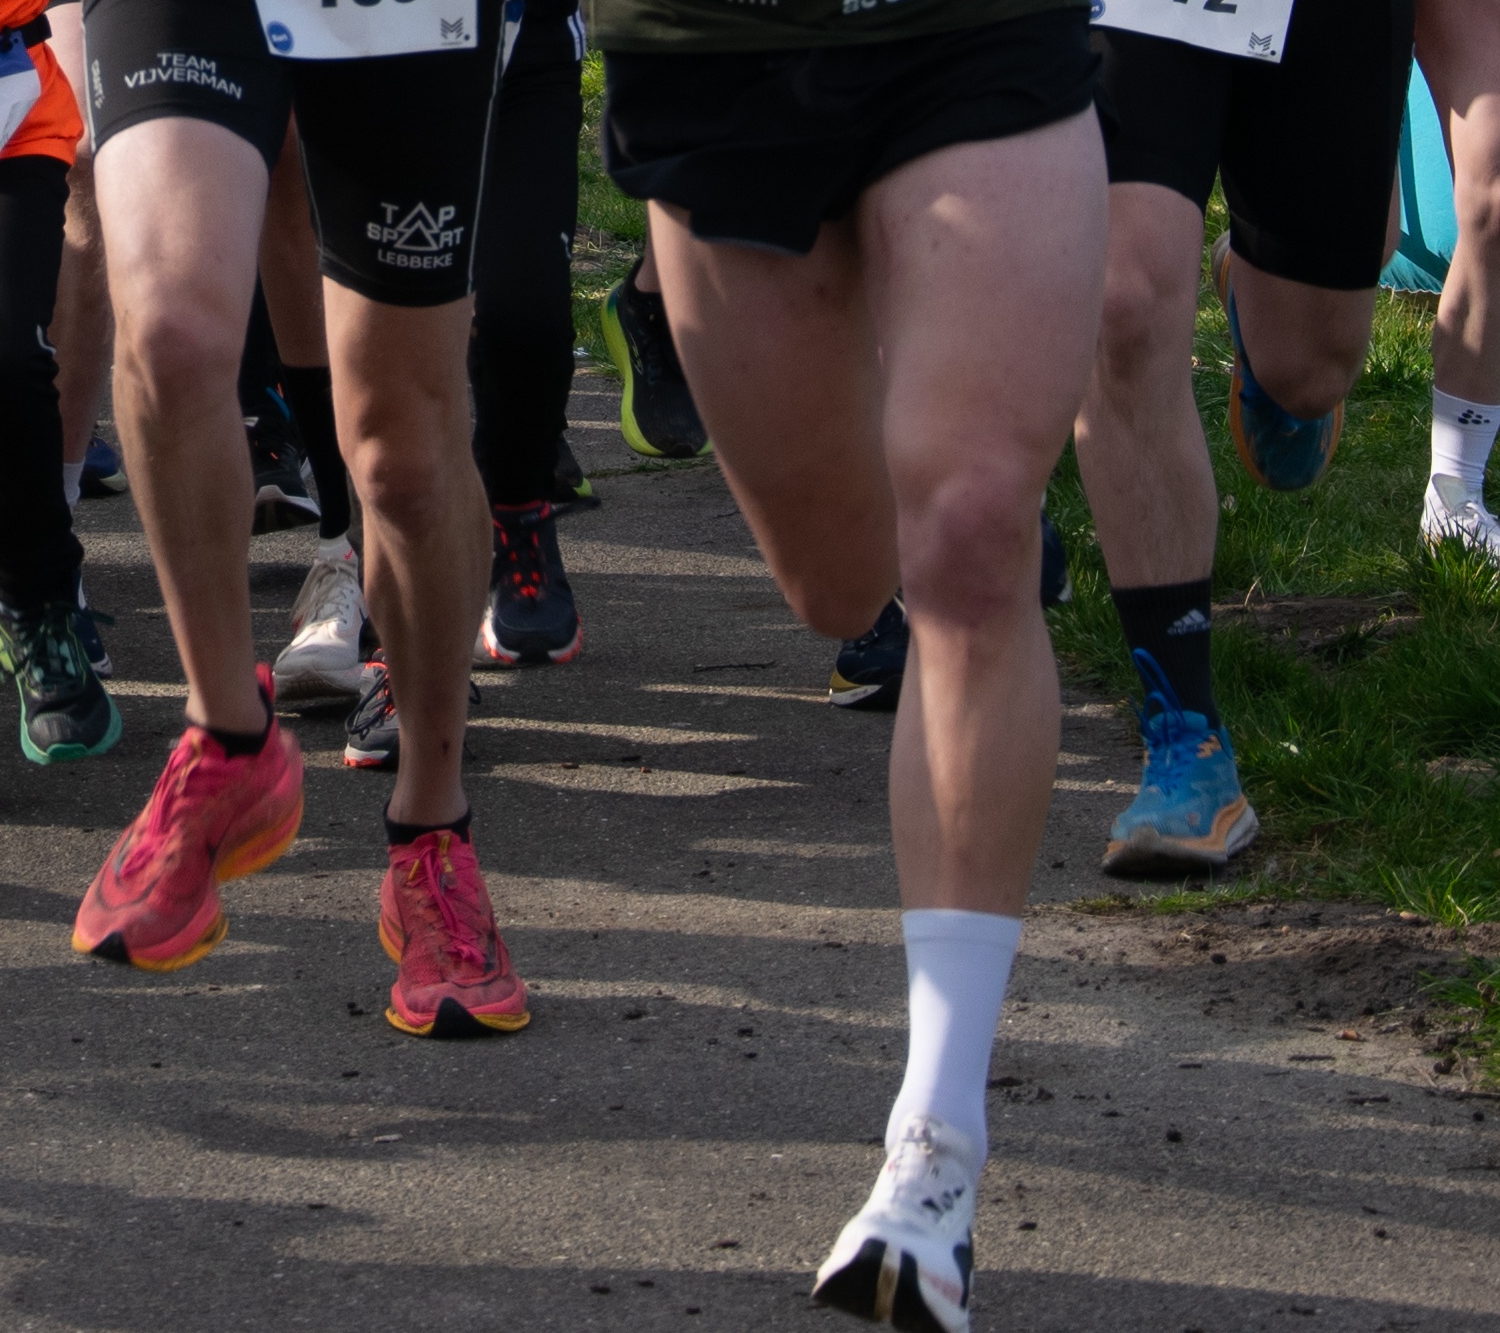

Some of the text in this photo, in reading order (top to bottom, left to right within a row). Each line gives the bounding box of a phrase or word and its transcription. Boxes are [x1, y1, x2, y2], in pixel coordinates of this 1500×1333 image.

[157, 52, 217, 74] TEAM
[124, 68, 243, 101] VIJVERMAN
[377, 248, 454, 269] LEBBEKE
